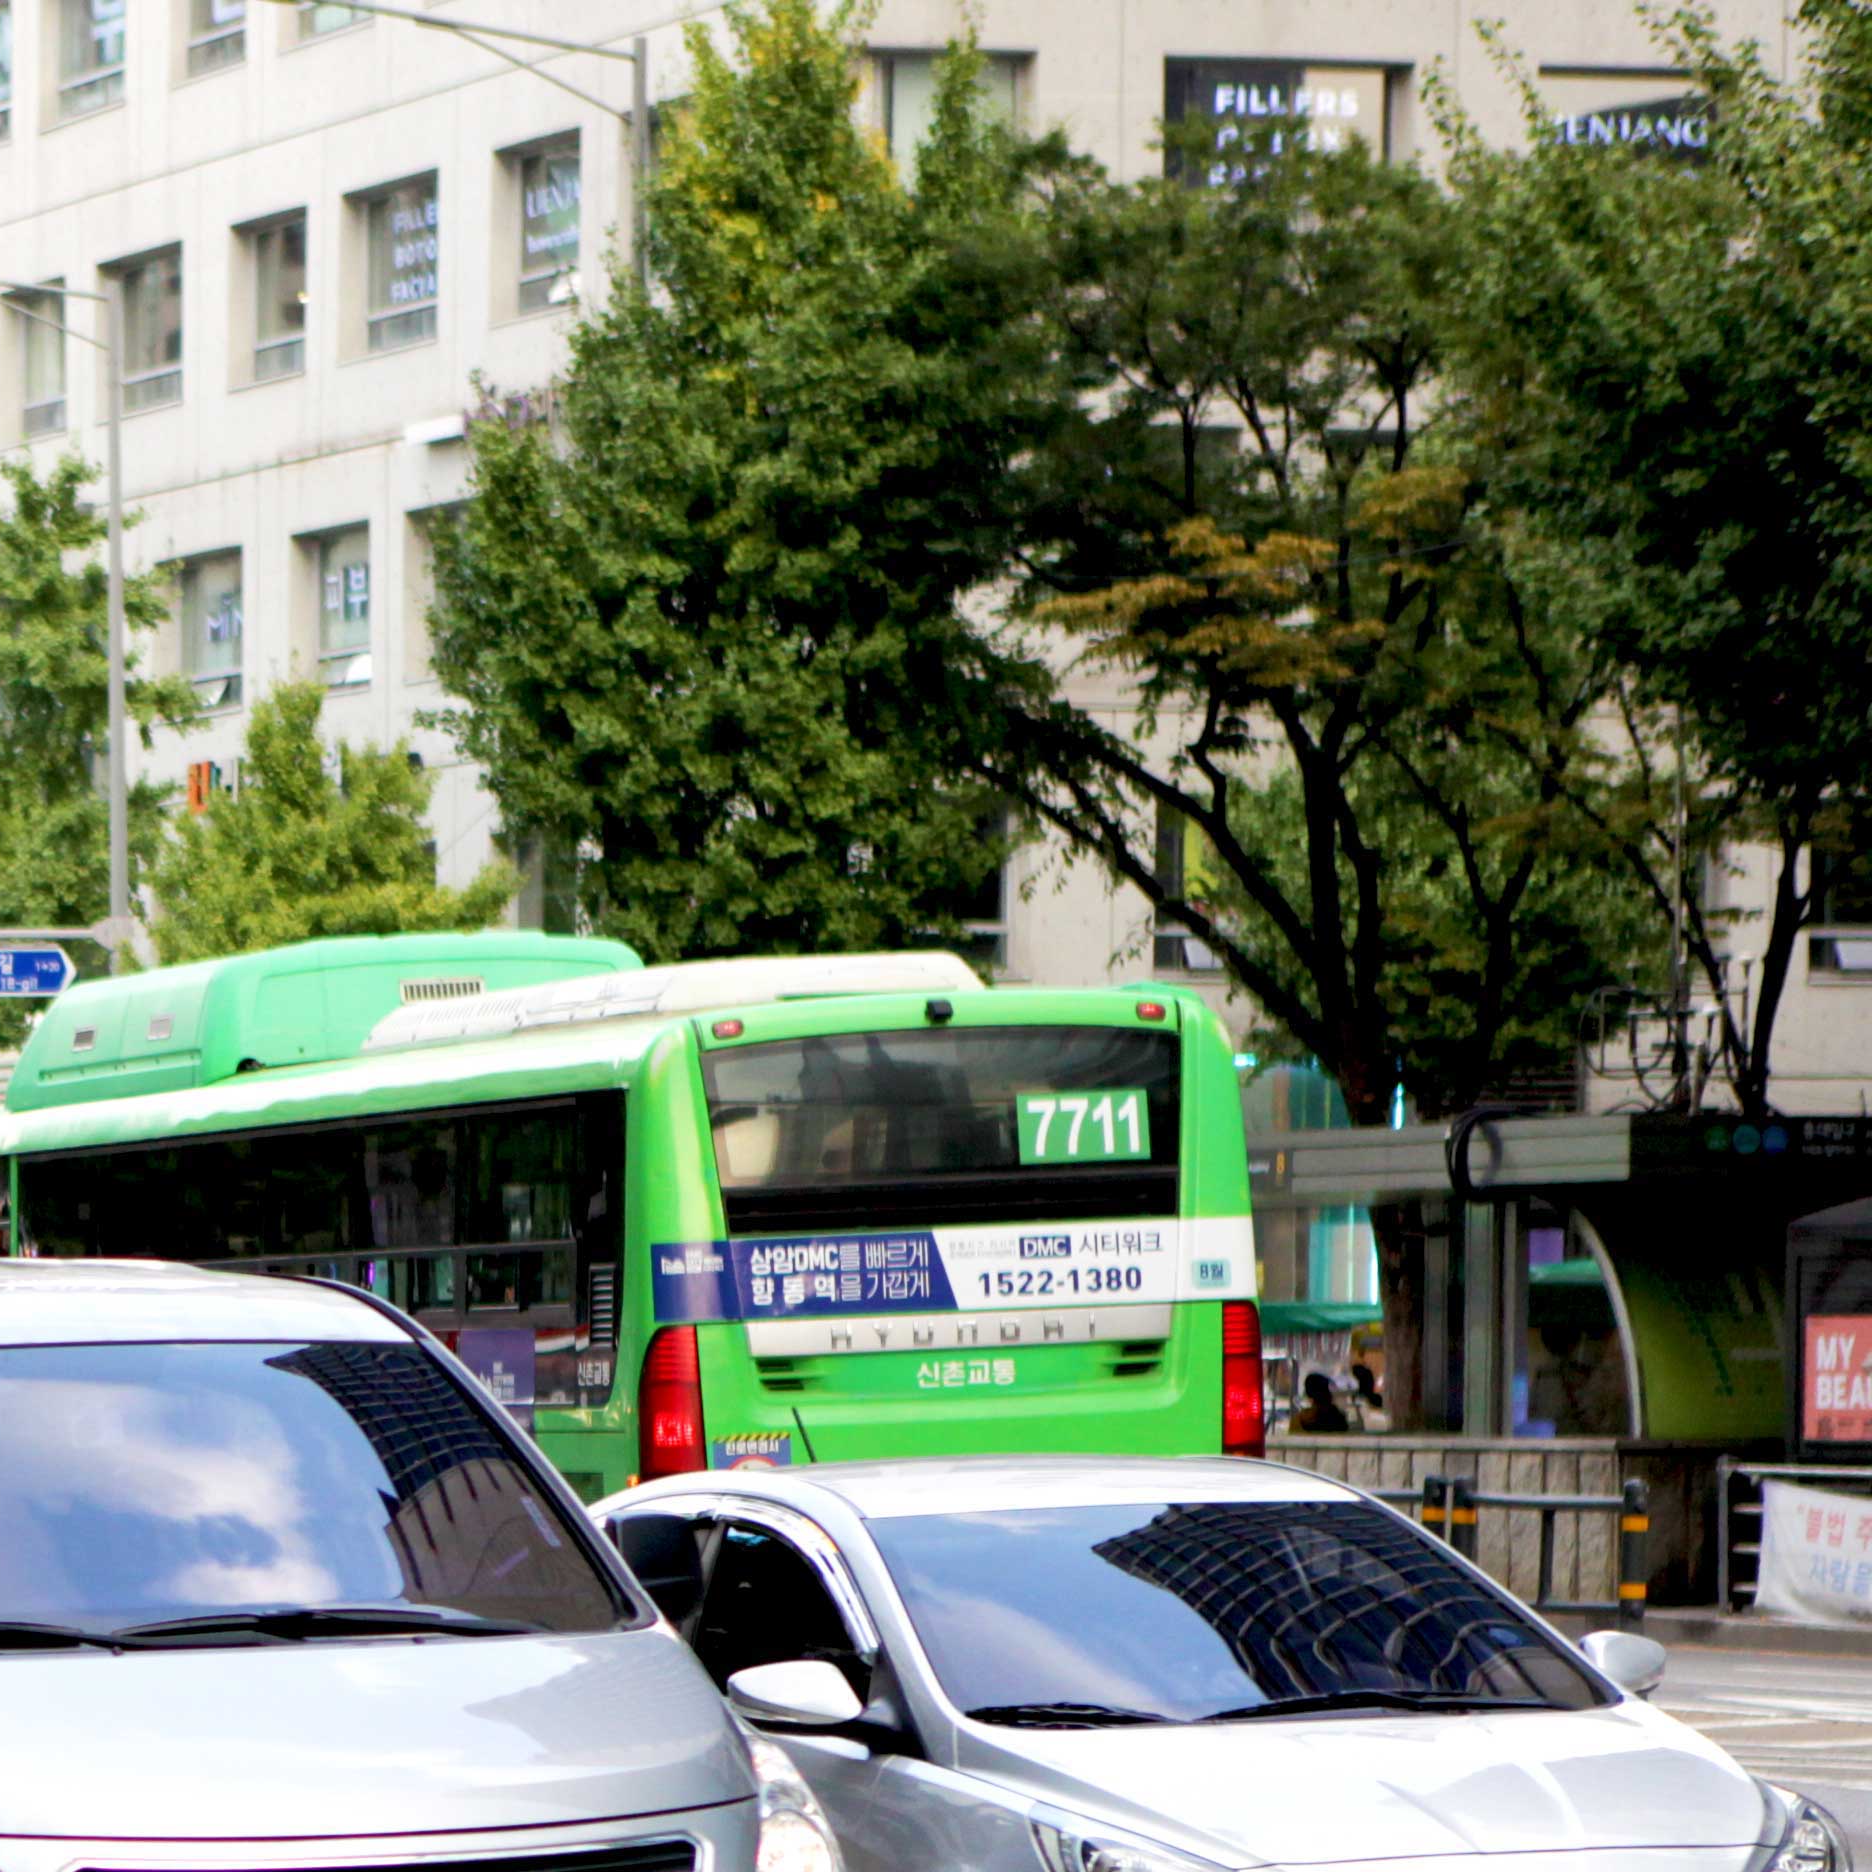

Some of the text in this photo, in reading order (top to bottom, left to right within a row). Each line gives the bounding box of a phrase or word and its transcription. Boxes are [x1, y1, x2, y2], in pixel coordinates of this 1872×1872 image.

[1215, 83, 1358, 117] FILLERS
[0, 976, 39, 993] 18-gil
[1025, 1094, 1143, 1159] 7711
[750, 1241, 861, 1277] 상암DMC를
[865, 1239, 930, 1270] 빠르게
[1022, 1236, 1069, 1258] DMC
[1078, 1230, 1165, 1254] 시티워크
[865, 1271, 930, 1300] 가깝게
[977, 1266, 1143, 1298] 1522-1380
[830, 1311, 1097, 1350] HYUNDAI
[1815, 1334, 1856, 1372] MY
[577, 1360, 610, 1387] 신촌교통
[916, 1358, 1017, 1389] 신촌교통
